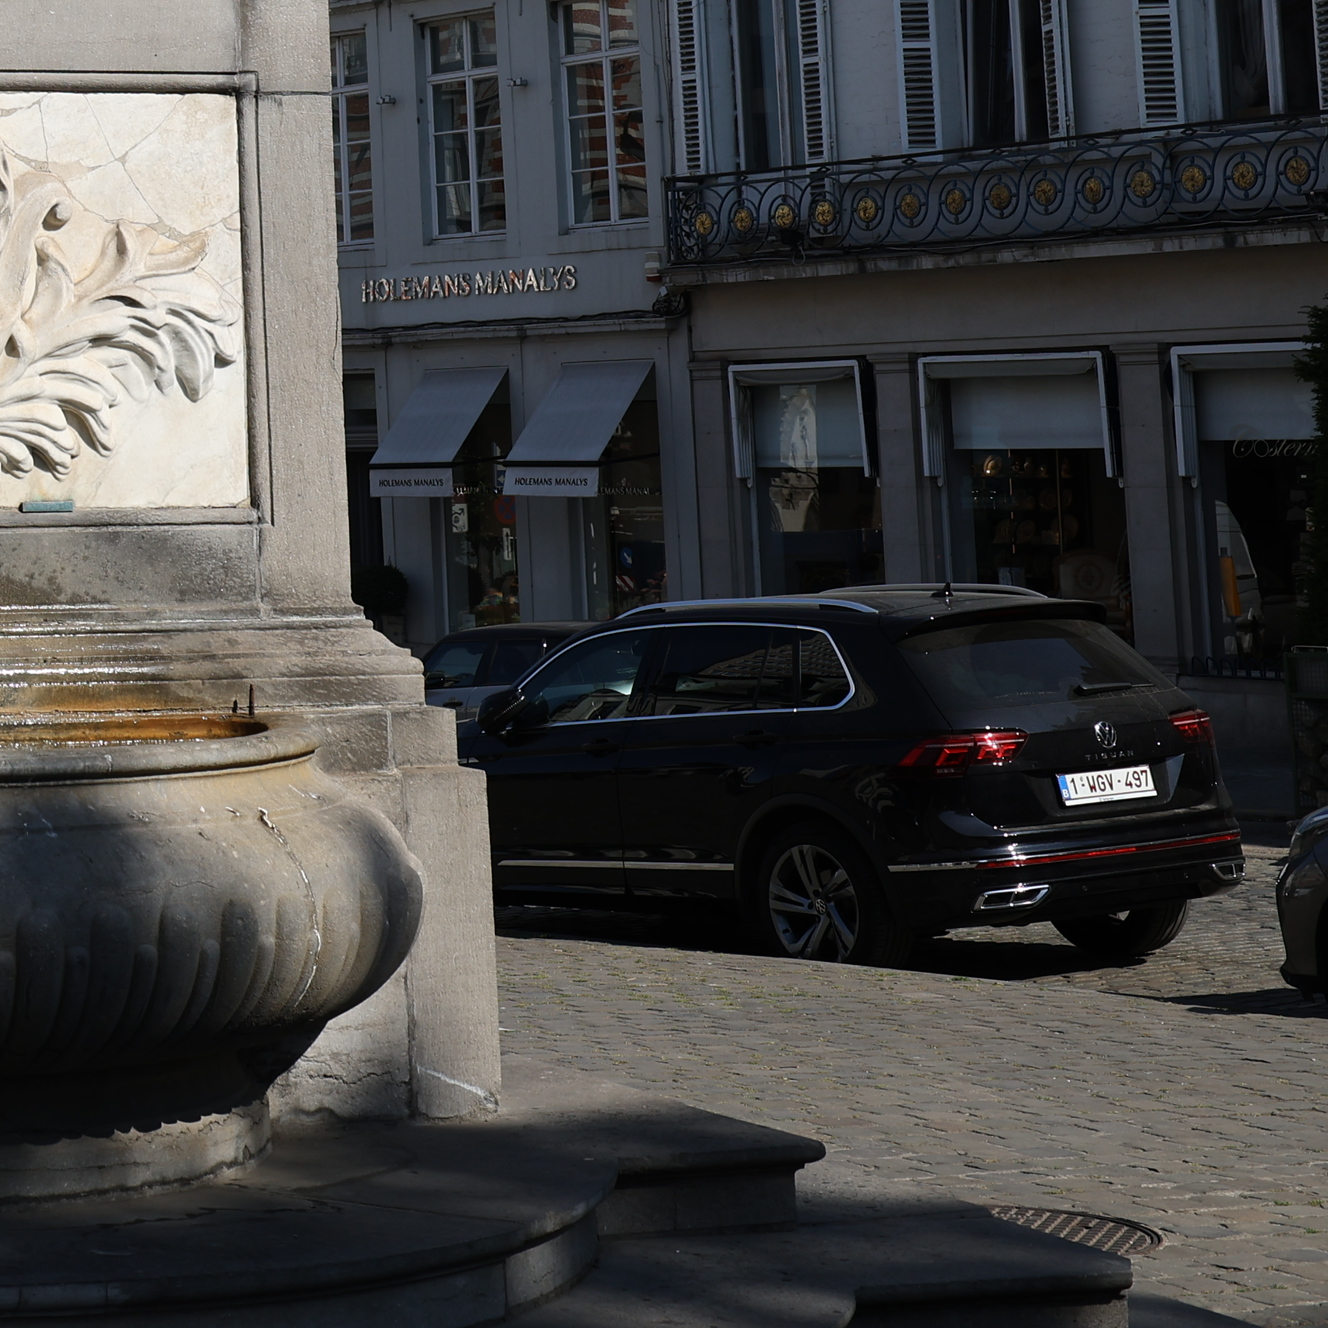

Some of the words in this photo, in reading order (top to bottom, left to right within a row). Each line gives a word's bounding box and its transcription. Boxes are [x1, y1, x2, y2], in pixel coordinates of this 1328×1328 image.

[361, 273, 471, 303] HOLEMANS
[474, 265, 577, 296] MANALYS
[378, 479, 412, 487] HOLEMANS
[414, 478, 444, 487] MANALYS
[514, 477, 552, 487] HOLEMANS
[555, 477, 588, 487] MANALYS
[1085, 749, 1135, 761] TIGUAN
[1062, 789, 1069, 799] B
